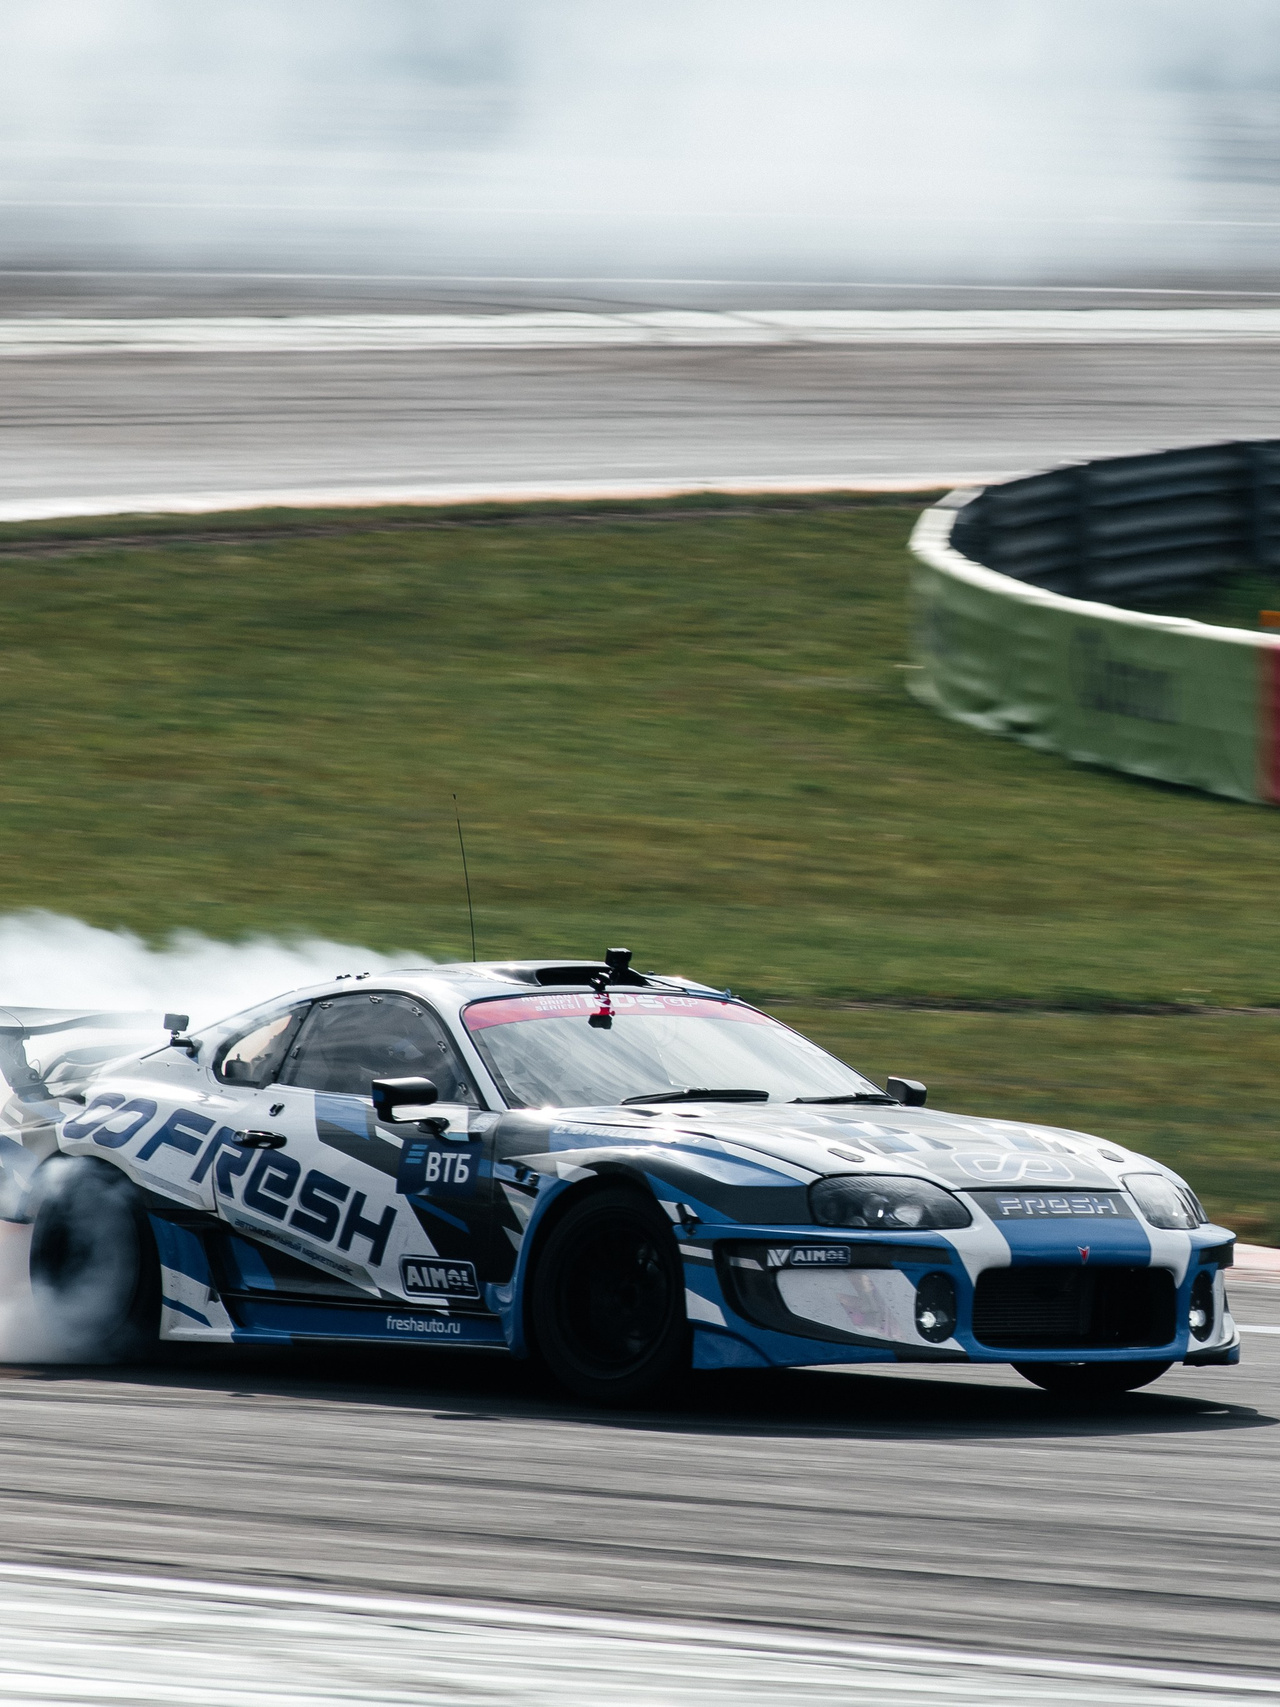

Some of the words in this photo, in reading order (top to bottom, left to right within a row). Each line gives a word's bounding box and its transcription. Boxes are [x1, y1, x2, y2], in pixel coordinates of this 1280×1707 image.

[535, 1004, 576, 1012] SERIES
[425, 1151, 472, 1184] ВТБ
[793, 1250, 847, 1262] AIMOL
[407, 1265, 475, 1292] AIMOL
[386, 1315, 461, 1335] freshauto.ru
